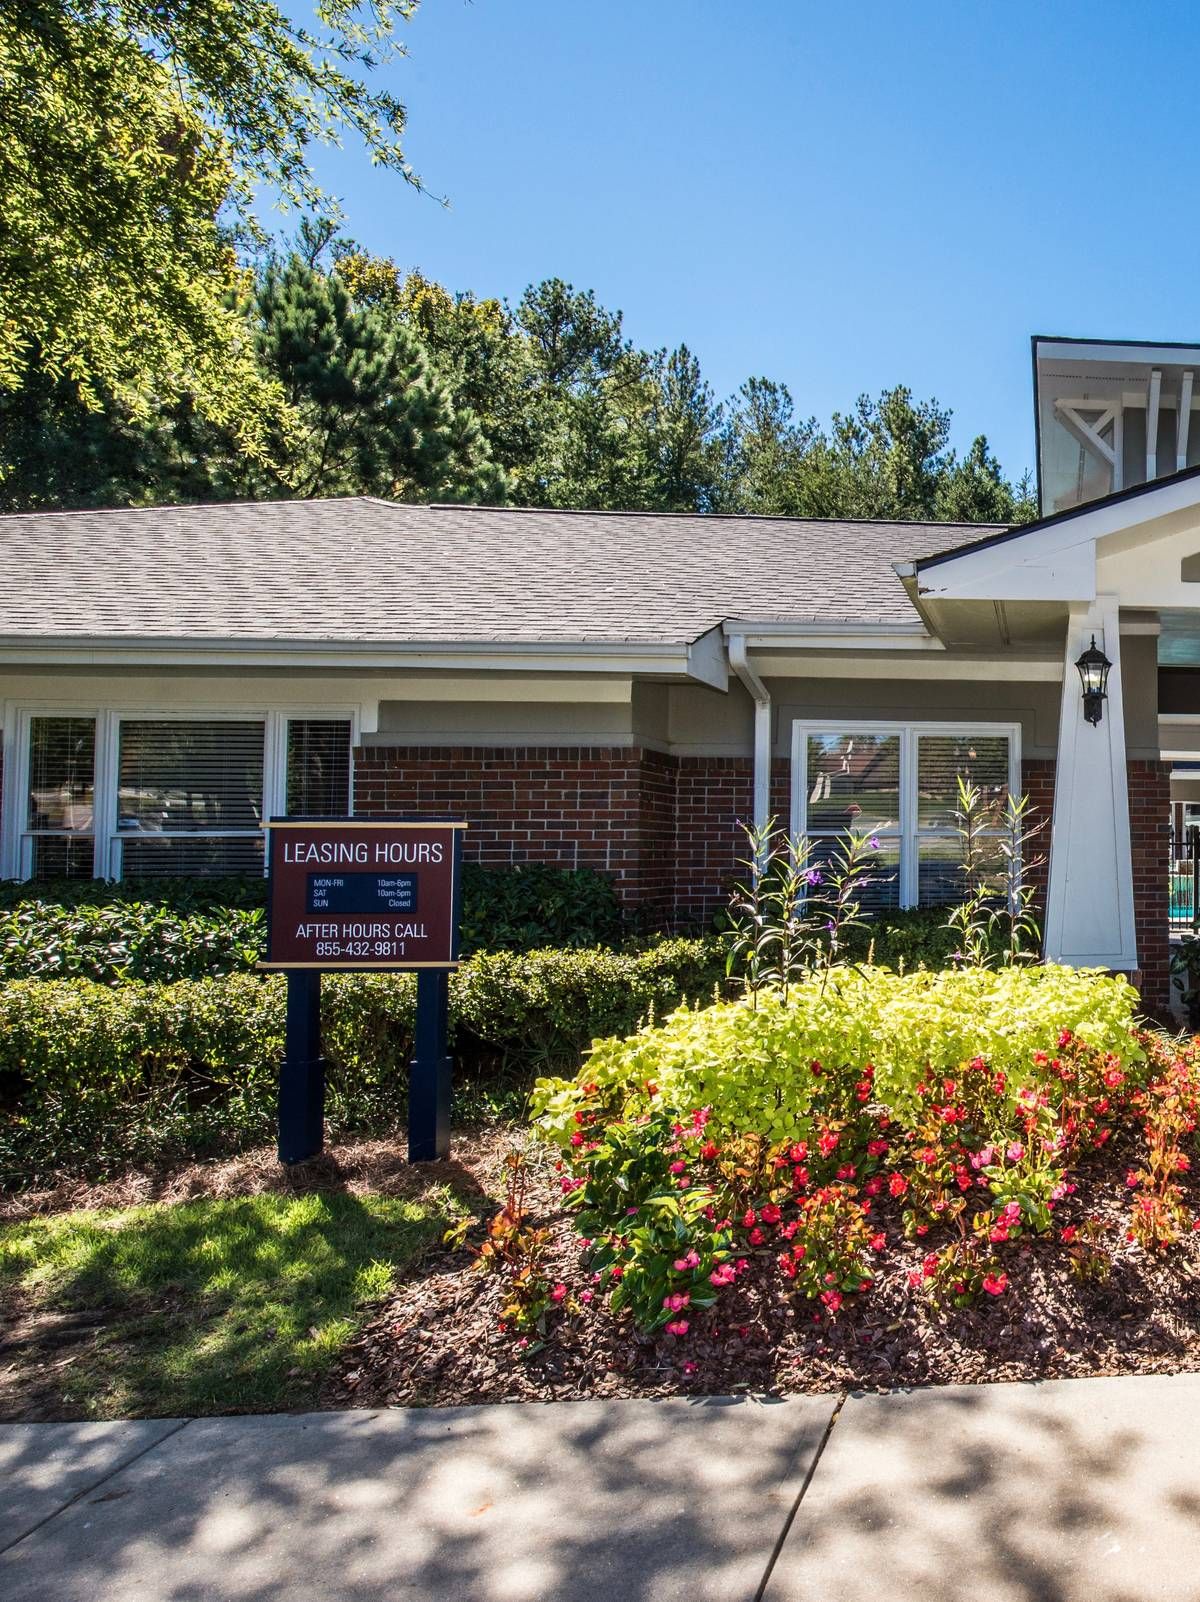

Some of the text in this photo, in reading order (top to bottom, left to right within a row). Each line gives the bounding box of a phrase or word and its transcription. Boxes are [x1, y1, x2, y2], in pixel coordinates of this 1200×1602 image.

[284, 842, 444, 863] LEASING HOURS
[313, 879, 412, 888] MON-FRI 10am-6pm
[313, 889, 411, 898] SAT 10am-5pm
[313, 899, 411, 907] SUN Closed
[295, 923, 428, 938] AFTER HOURS CALL
[316, 942, 405, 956] 855-432-9811
